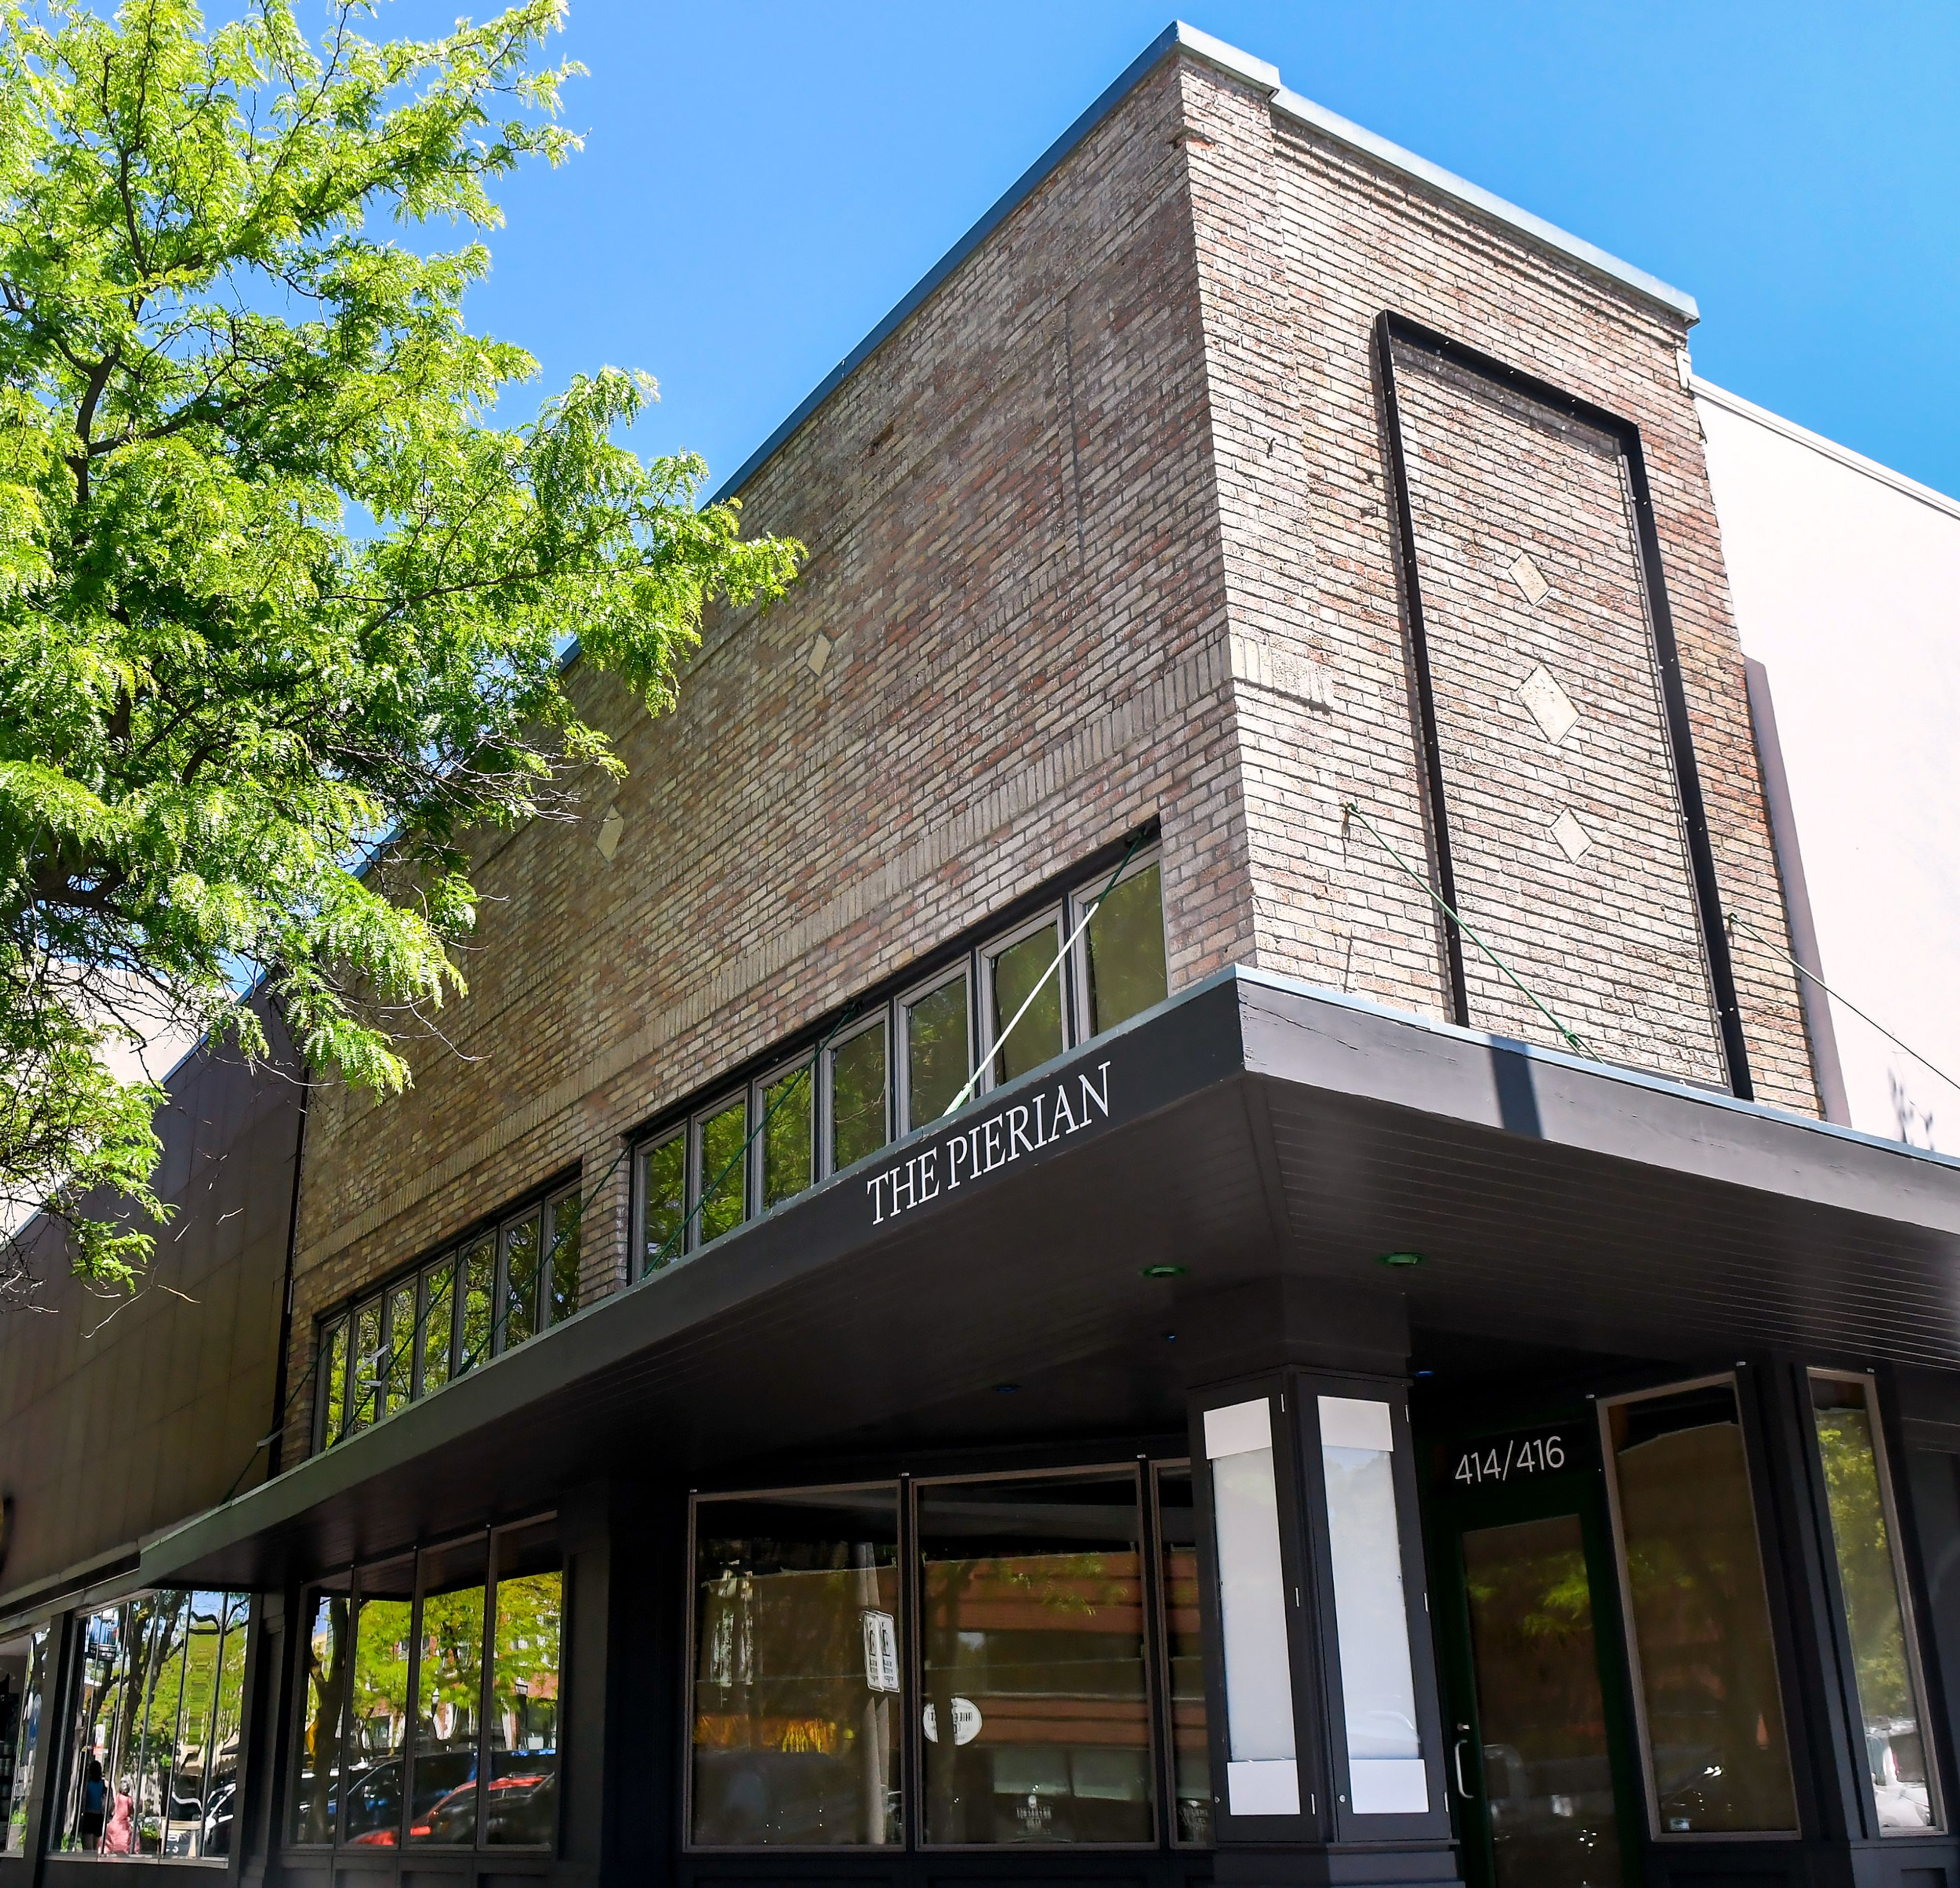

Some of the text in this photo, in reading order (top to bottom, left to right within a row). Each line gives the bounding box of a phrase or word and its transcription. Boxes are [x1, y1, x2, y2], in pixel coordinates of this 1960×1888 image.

[867, 1061, 1111, 1225] THE PIERIAN
[1455, 1435, 1565, 1485] 414/416
